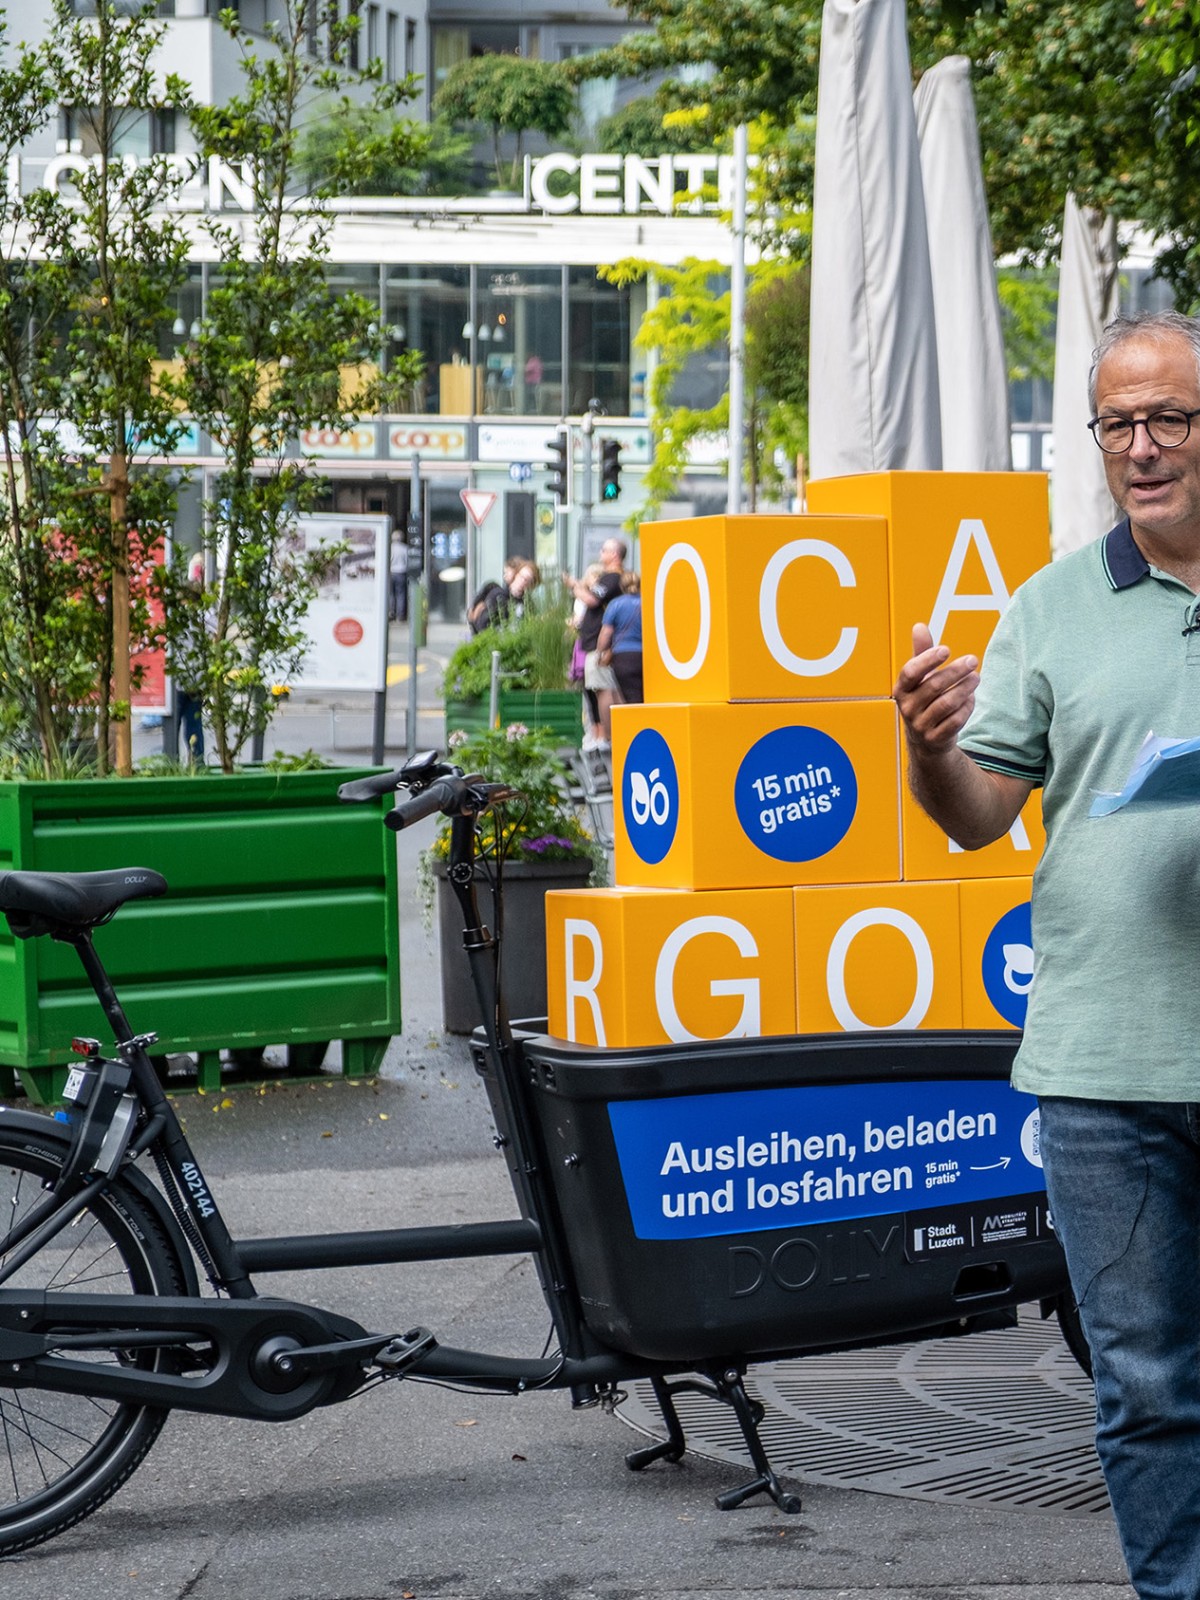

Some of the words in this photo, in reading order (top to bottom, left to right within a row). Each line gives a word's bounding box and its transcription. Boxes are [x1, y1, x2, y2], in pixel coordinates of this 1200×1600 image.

[531, 152, 760, 214] CENTE
[302, 427, 374, 455] coop
[391, 430, 464, 455] coop
[752, 774, 781, 802] 15
[784, 764, 832, 794] min
[124, 876, 148, 884] DOLLY
[24, 1144, 63, 1162] SCHWAL
[660, 1130, 856, 1175] Ausleihen,
[864, 1109, 997, 1154] beladen
[925, 1162, 937, 1174] 15
[938, 1159, 959, 1172] min
[181, 1162, 215, 1218] 402144
[661, 1180, 735, 1218] und
[747, 1163, 913, 1210] losfahren
[928, 1224, 957, 1238] Stadt
[928, 1236, 964, 1250] Luzern
[729, 1226, 899, 1298] DOLLY
